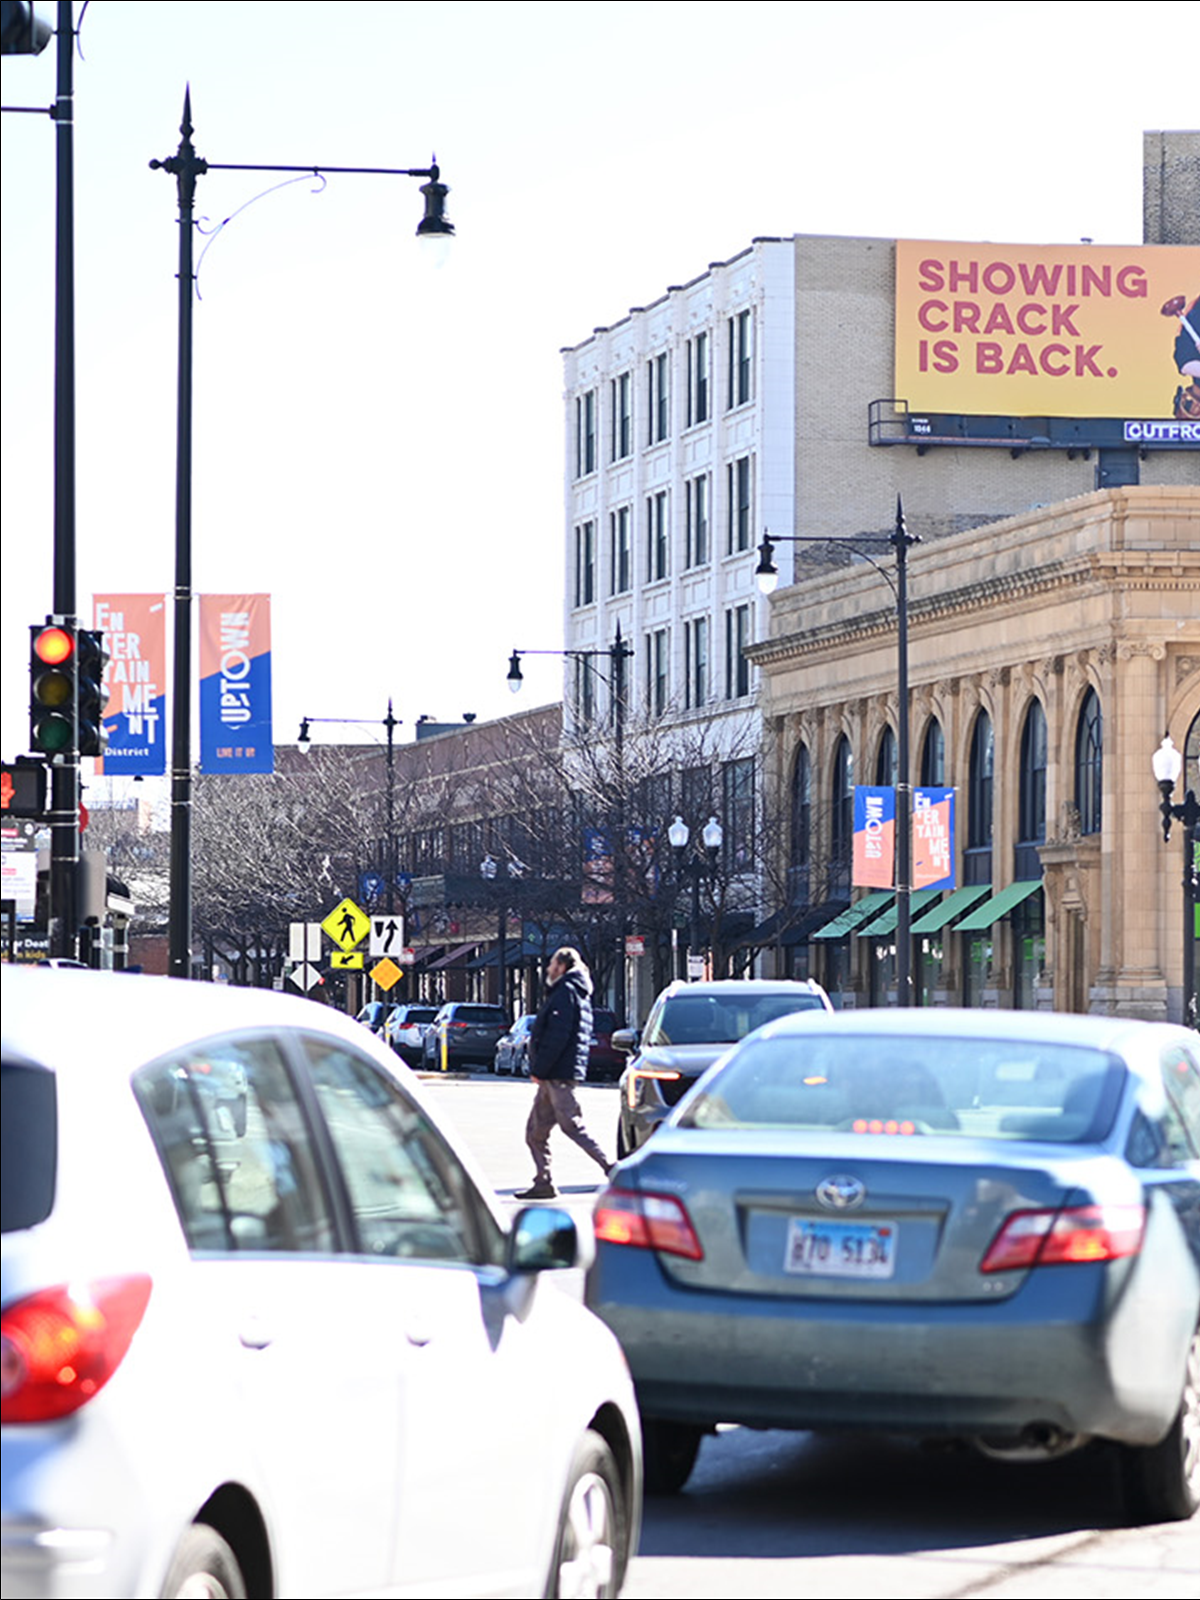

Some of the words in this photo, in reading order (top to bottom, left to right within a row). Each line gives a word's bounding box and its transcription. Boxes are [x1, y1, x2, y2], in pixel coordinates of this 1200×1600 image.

[918, 259, 1148, 298] SHOWING
[918, 299, 1081, 337] CRACK
[919, 340, 959, 374] IS
[976, 342, 1118, 378] BACK.
[221, 612, 251, 724] UPTOWN
[122, 684, 157, 713] ME
[104, 747, 149, 757] District
